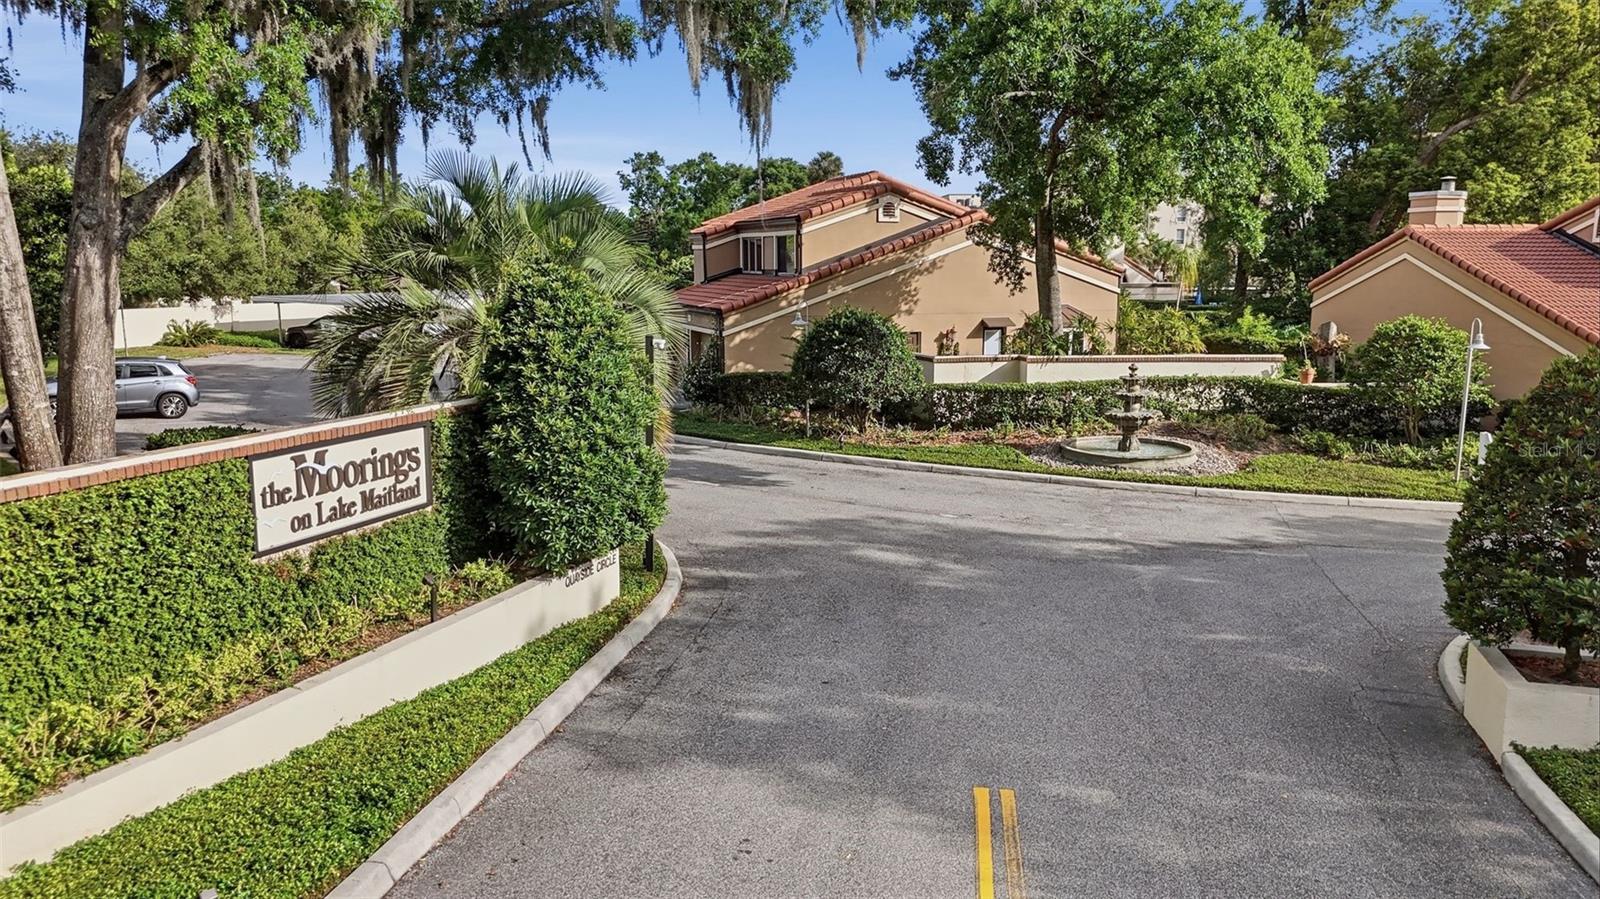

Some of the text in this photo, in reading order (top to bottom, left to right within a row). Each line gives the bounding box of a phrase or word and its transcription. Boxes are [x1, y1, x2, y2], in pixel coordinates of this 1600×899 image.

[260, 446, 421, 509] the Moorings
[290, 476, 421, 533] on Lake Maitland
[596, 554, 616, 572] CIRCLE
